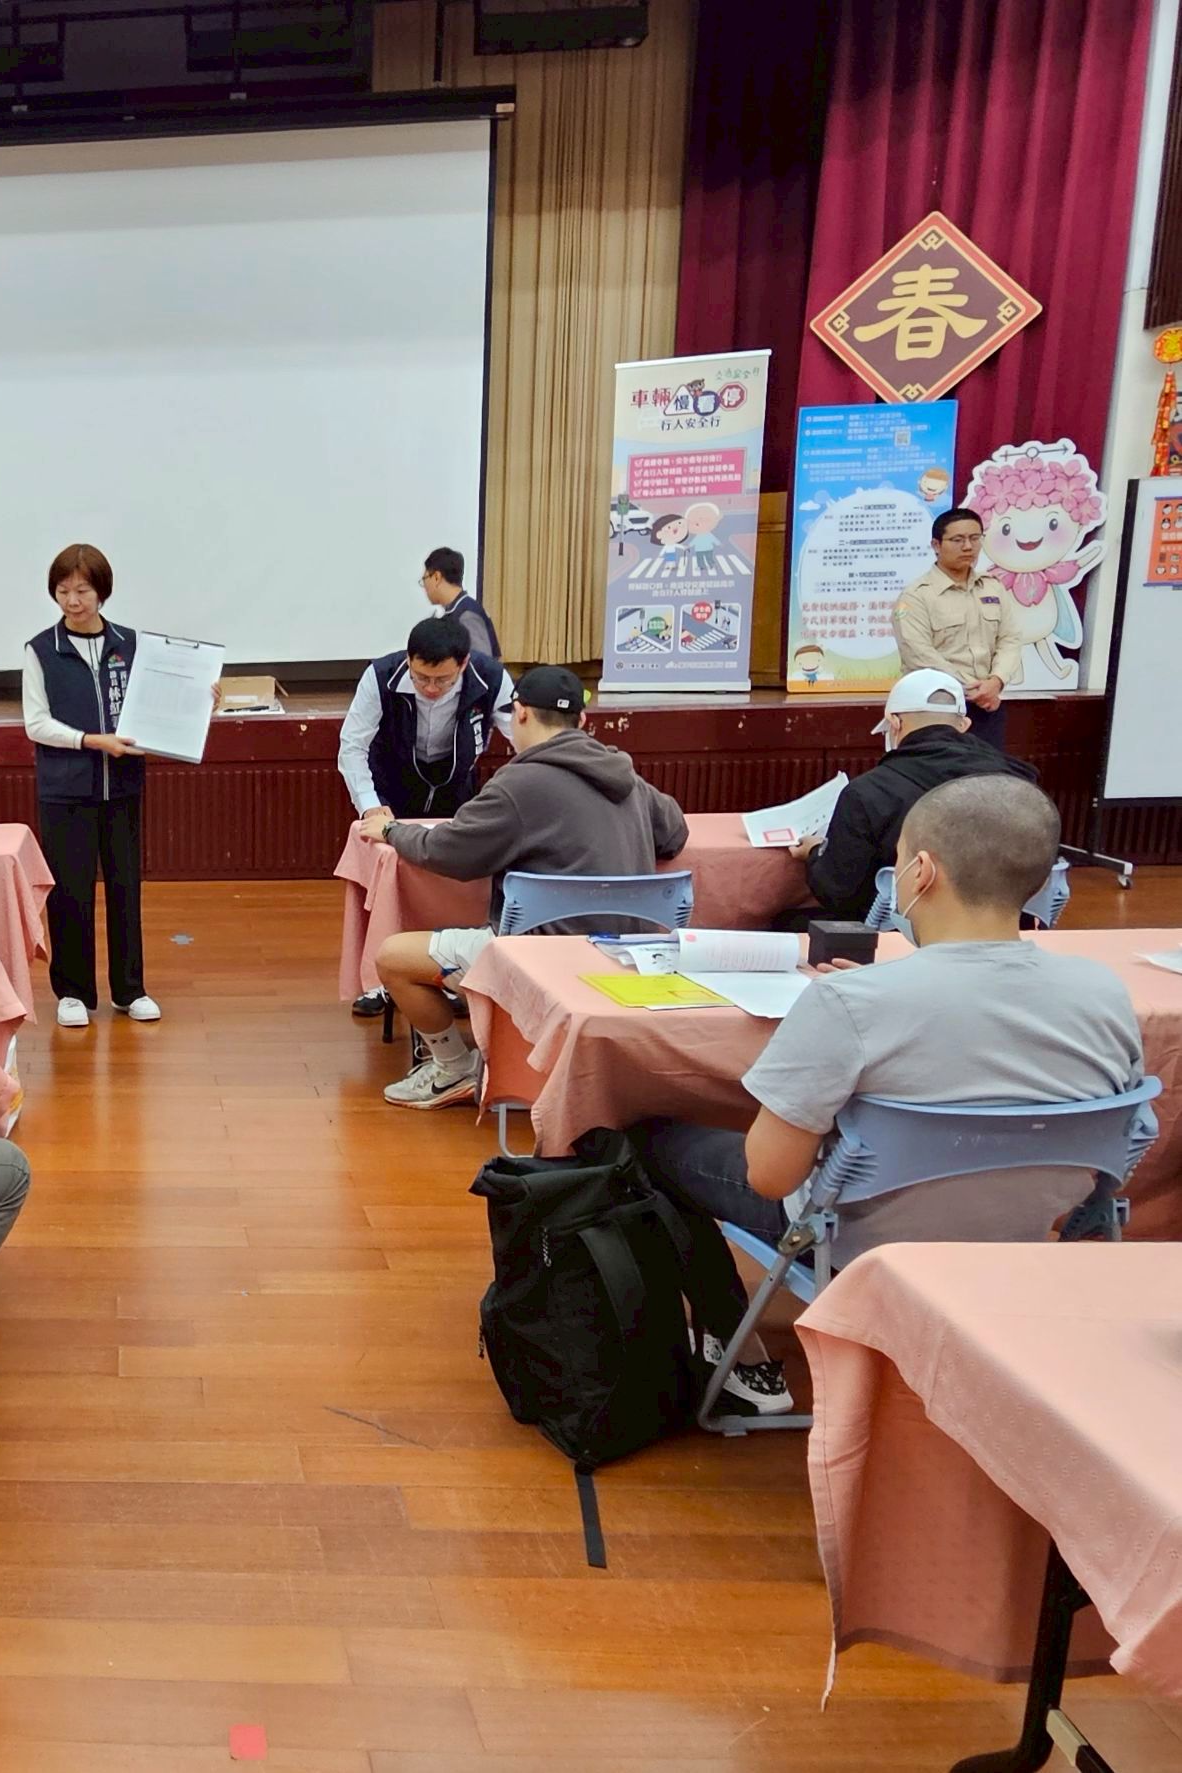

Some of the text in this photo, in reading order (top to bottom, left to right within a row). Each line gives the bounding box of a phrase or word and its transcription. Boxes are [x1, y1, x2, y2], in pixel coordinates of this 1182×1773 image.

[853, 263, 988, 361] 春
[661, 416, 721, 431] 行人安全行
